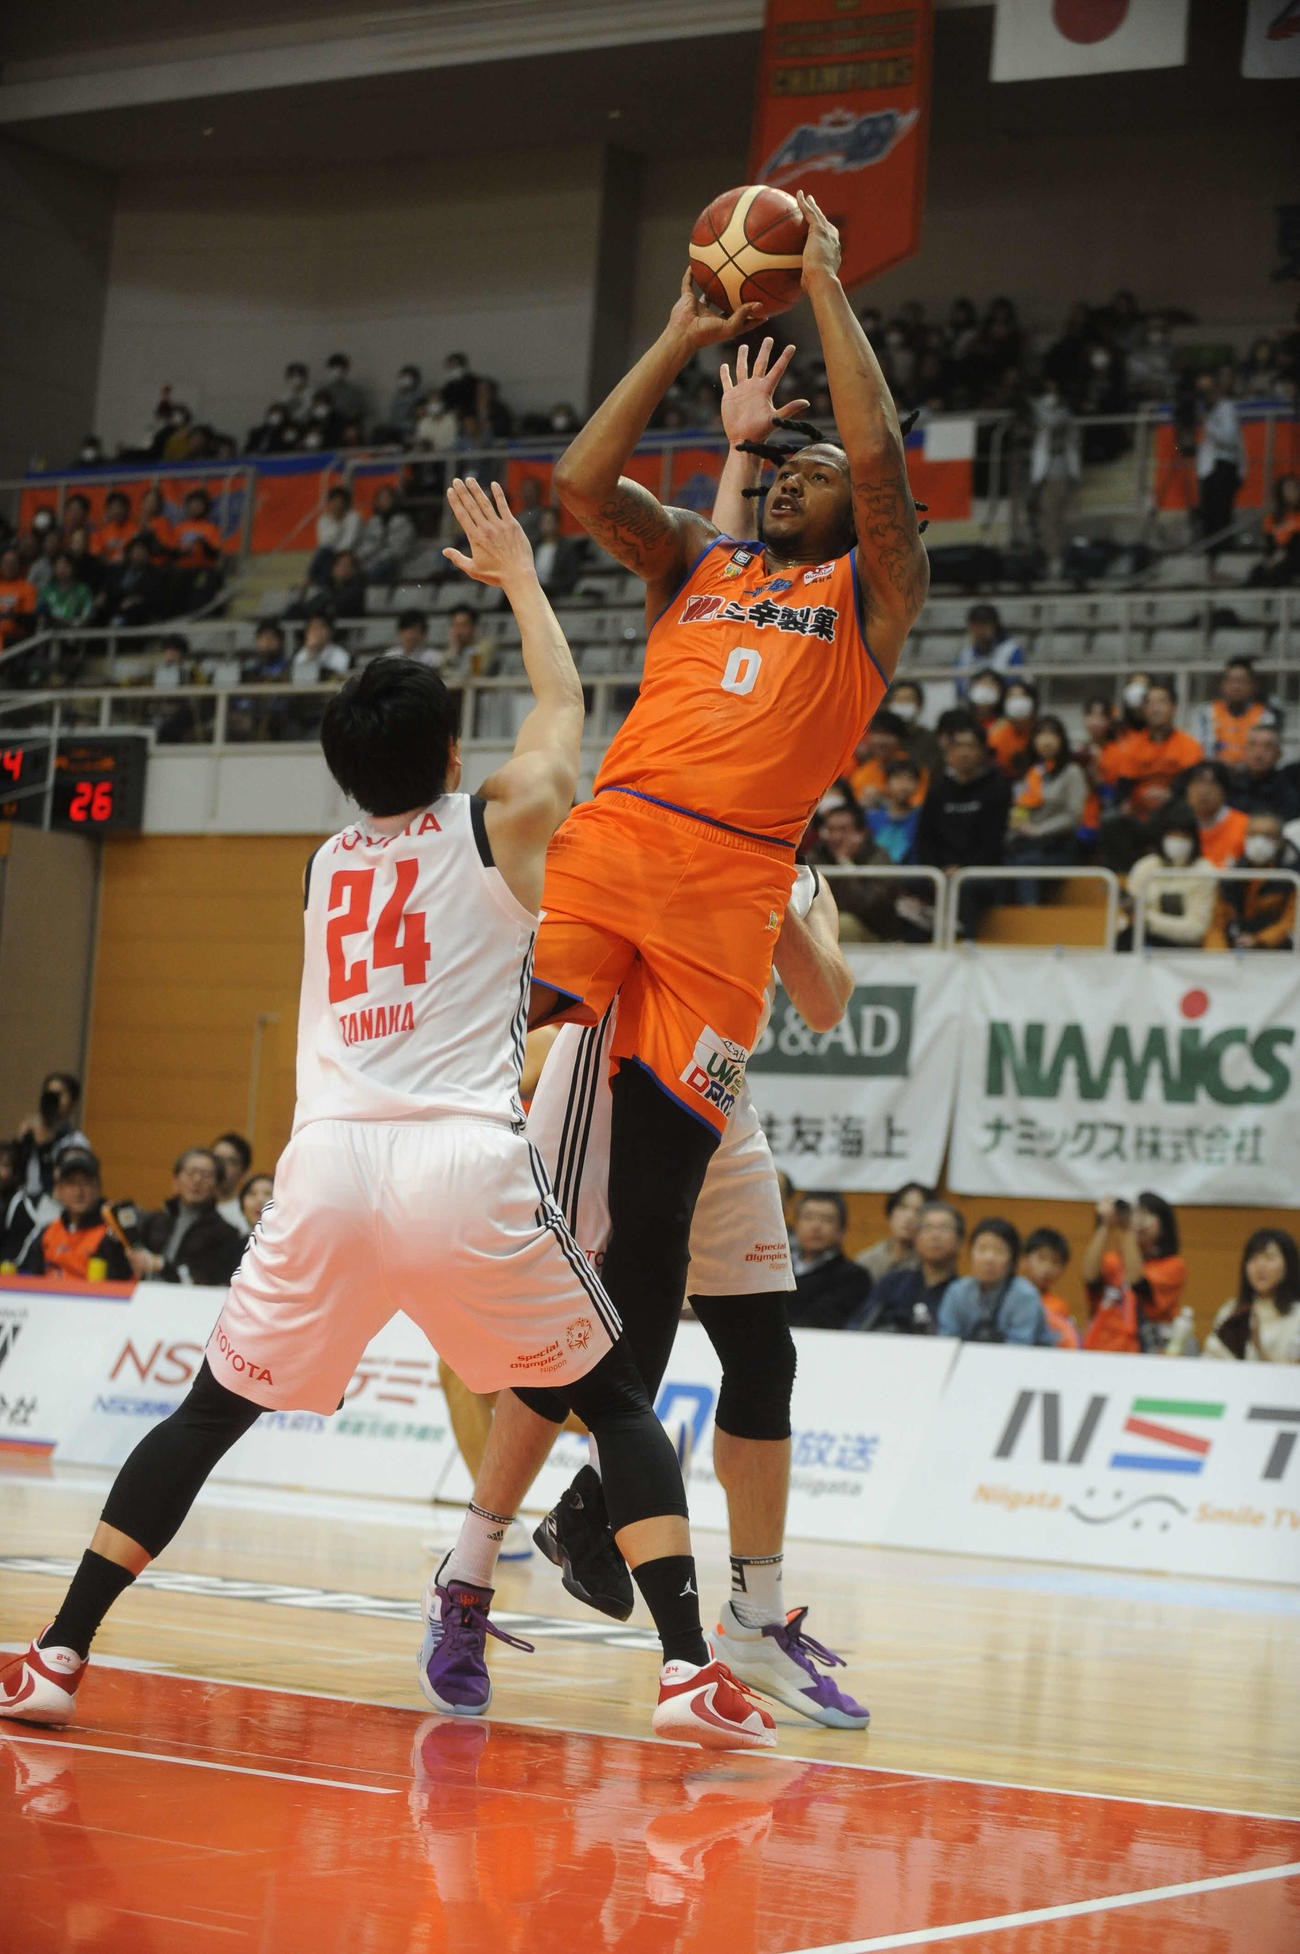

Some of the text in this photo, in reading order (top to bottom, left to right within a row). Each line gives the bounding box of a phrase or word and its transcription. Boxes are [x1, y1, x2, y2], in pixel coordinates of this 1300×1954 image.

[720, 647, 762, 696] 0
[0, 748, 24, 781] 4
[69, 781, 113, 822] 26
[327, 858, 431, 1004] 24
[339, 1001, 415, 1047] TANAKA
[214, 1325, 274, 1386] TOYOTA
[510, 1350, 564, 1369] Olympics
[517, 1340, 560, 1361] Special
[791, 1429, 880, 1473] 放送
[973, 1484, 1062, 1511] Niigata
[1195, 1503, 1265, 1528] Smile
[56, 1653, 71, 1663] 24
[665, 1665, 679, 1674] 24
